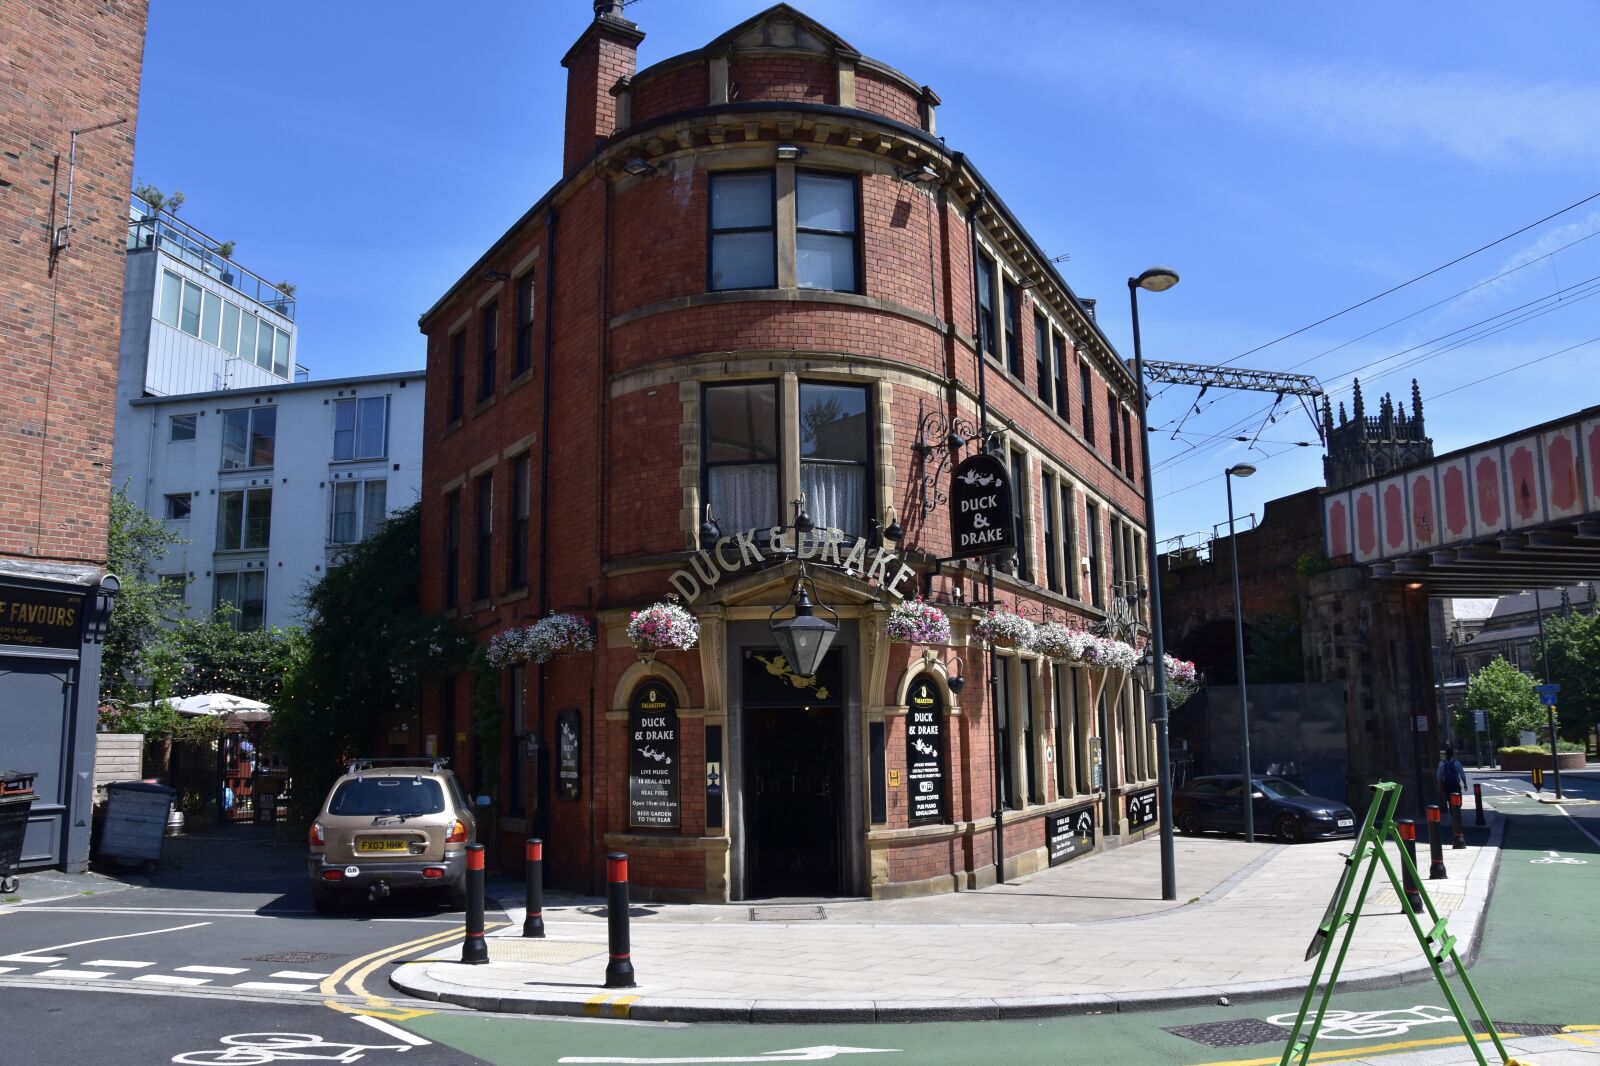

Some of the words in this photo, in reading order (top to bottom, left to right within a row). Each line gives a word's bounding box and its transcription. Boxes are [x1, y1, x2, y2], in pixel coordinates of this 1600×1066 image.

[961, 495, 998, 513] DUCK
[973, 513, 991, 529] &
[961, 528, 1004, 546] DRAKE
[668, 528, 766, 604] DUCK
[769, 526, 787, 553] &
[797, 527, 916, 600] DRAKE
[9, 602, 76, 627] FAVOURS
[641, 717, 666, 728] DUCK
[914, 712, 933, 722] DUCK
[634, 731, 644, 741] &
[646, 730, 674, 740] DRAKE
[909, 725, 916, 735] &
[917, 725, 939, 735] DRAKE
[361, 841, 384, 850] FX03
[386, 841, 403, 849] HHK
